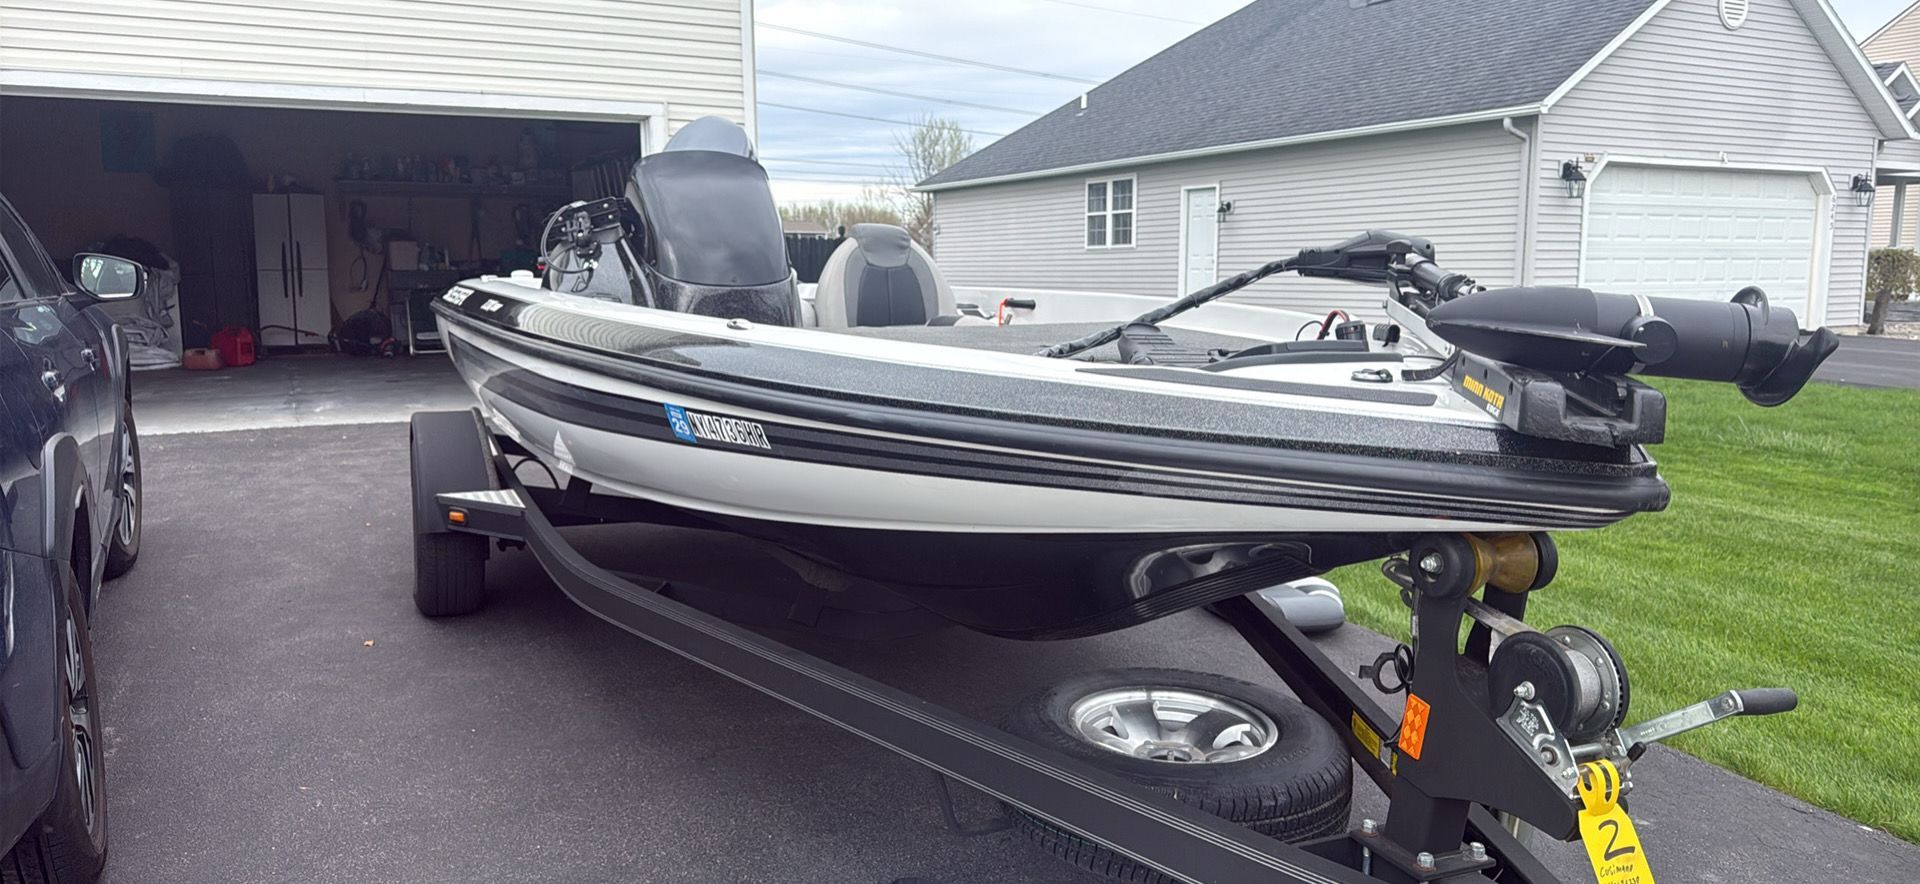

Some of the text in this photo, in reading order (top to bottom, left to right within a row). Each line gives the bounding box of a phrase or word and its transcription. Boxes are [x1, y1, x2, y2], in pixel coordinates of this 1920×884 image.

[1482, 386, 1505, 410] KOTA
[671, 417, 690, 436] 29
[1598, 819, 1636, 862] 2
